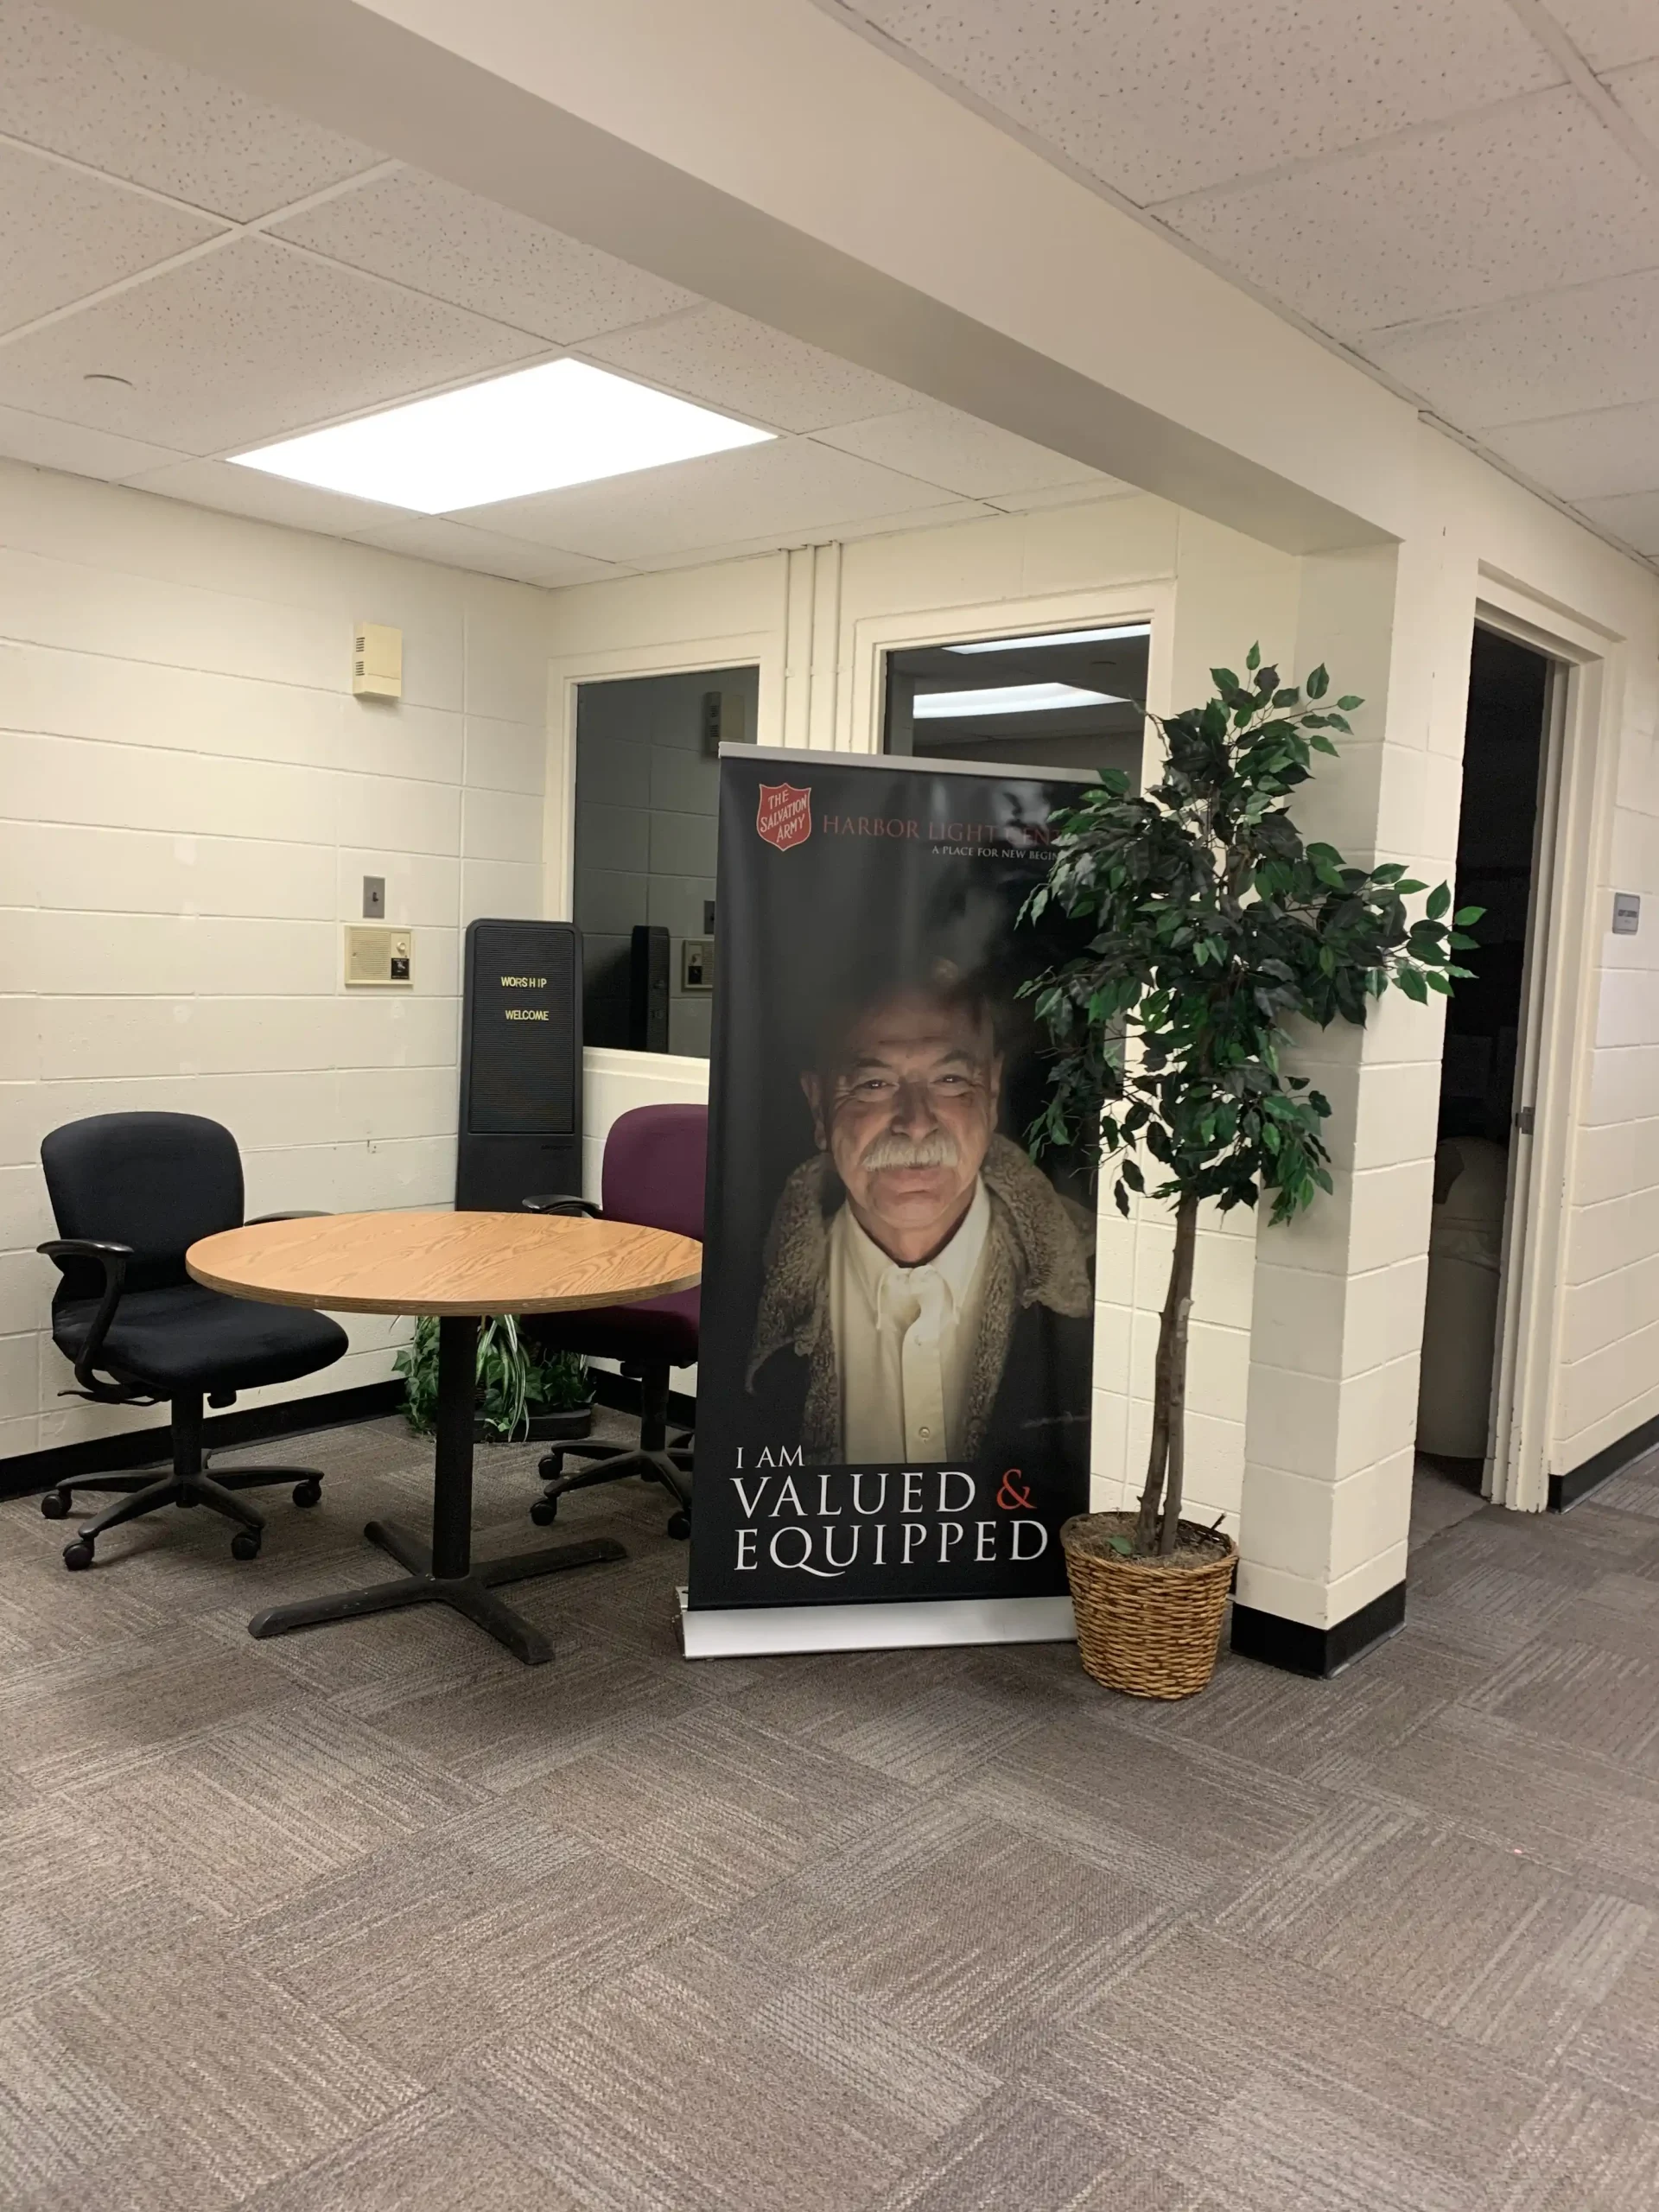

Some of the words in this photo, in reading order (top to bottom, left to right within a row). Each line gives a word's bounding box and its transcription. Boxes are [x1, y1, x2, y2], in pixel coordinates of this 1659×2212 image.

[768, 789, 790, 810] THE
[760, 793, 808, 833] SALVATION
[776, 813, 805, 843] ARMY
[823, 815, 920, 838] HARBOR
[929, 822, 999, 843] LIGHT
[931, 845, 940, 855] A
[942, 846, 974, 856] PLACE
[977, 848, 999, 857] FOR
[1001, 849, 1027, 859] NEW
[501, 976, 547, 988] WORSHIP
[505, 1010, 550, 1020] WELCOME
[735, 1446, 744, 1469] I
[755, 1445, 805, 1467] AM
[729, 1471, 976, 1519] VALUED
[996, 1468, 1038, 1510] &
[734, 1520, 1049, 1578] EQUIPPED
